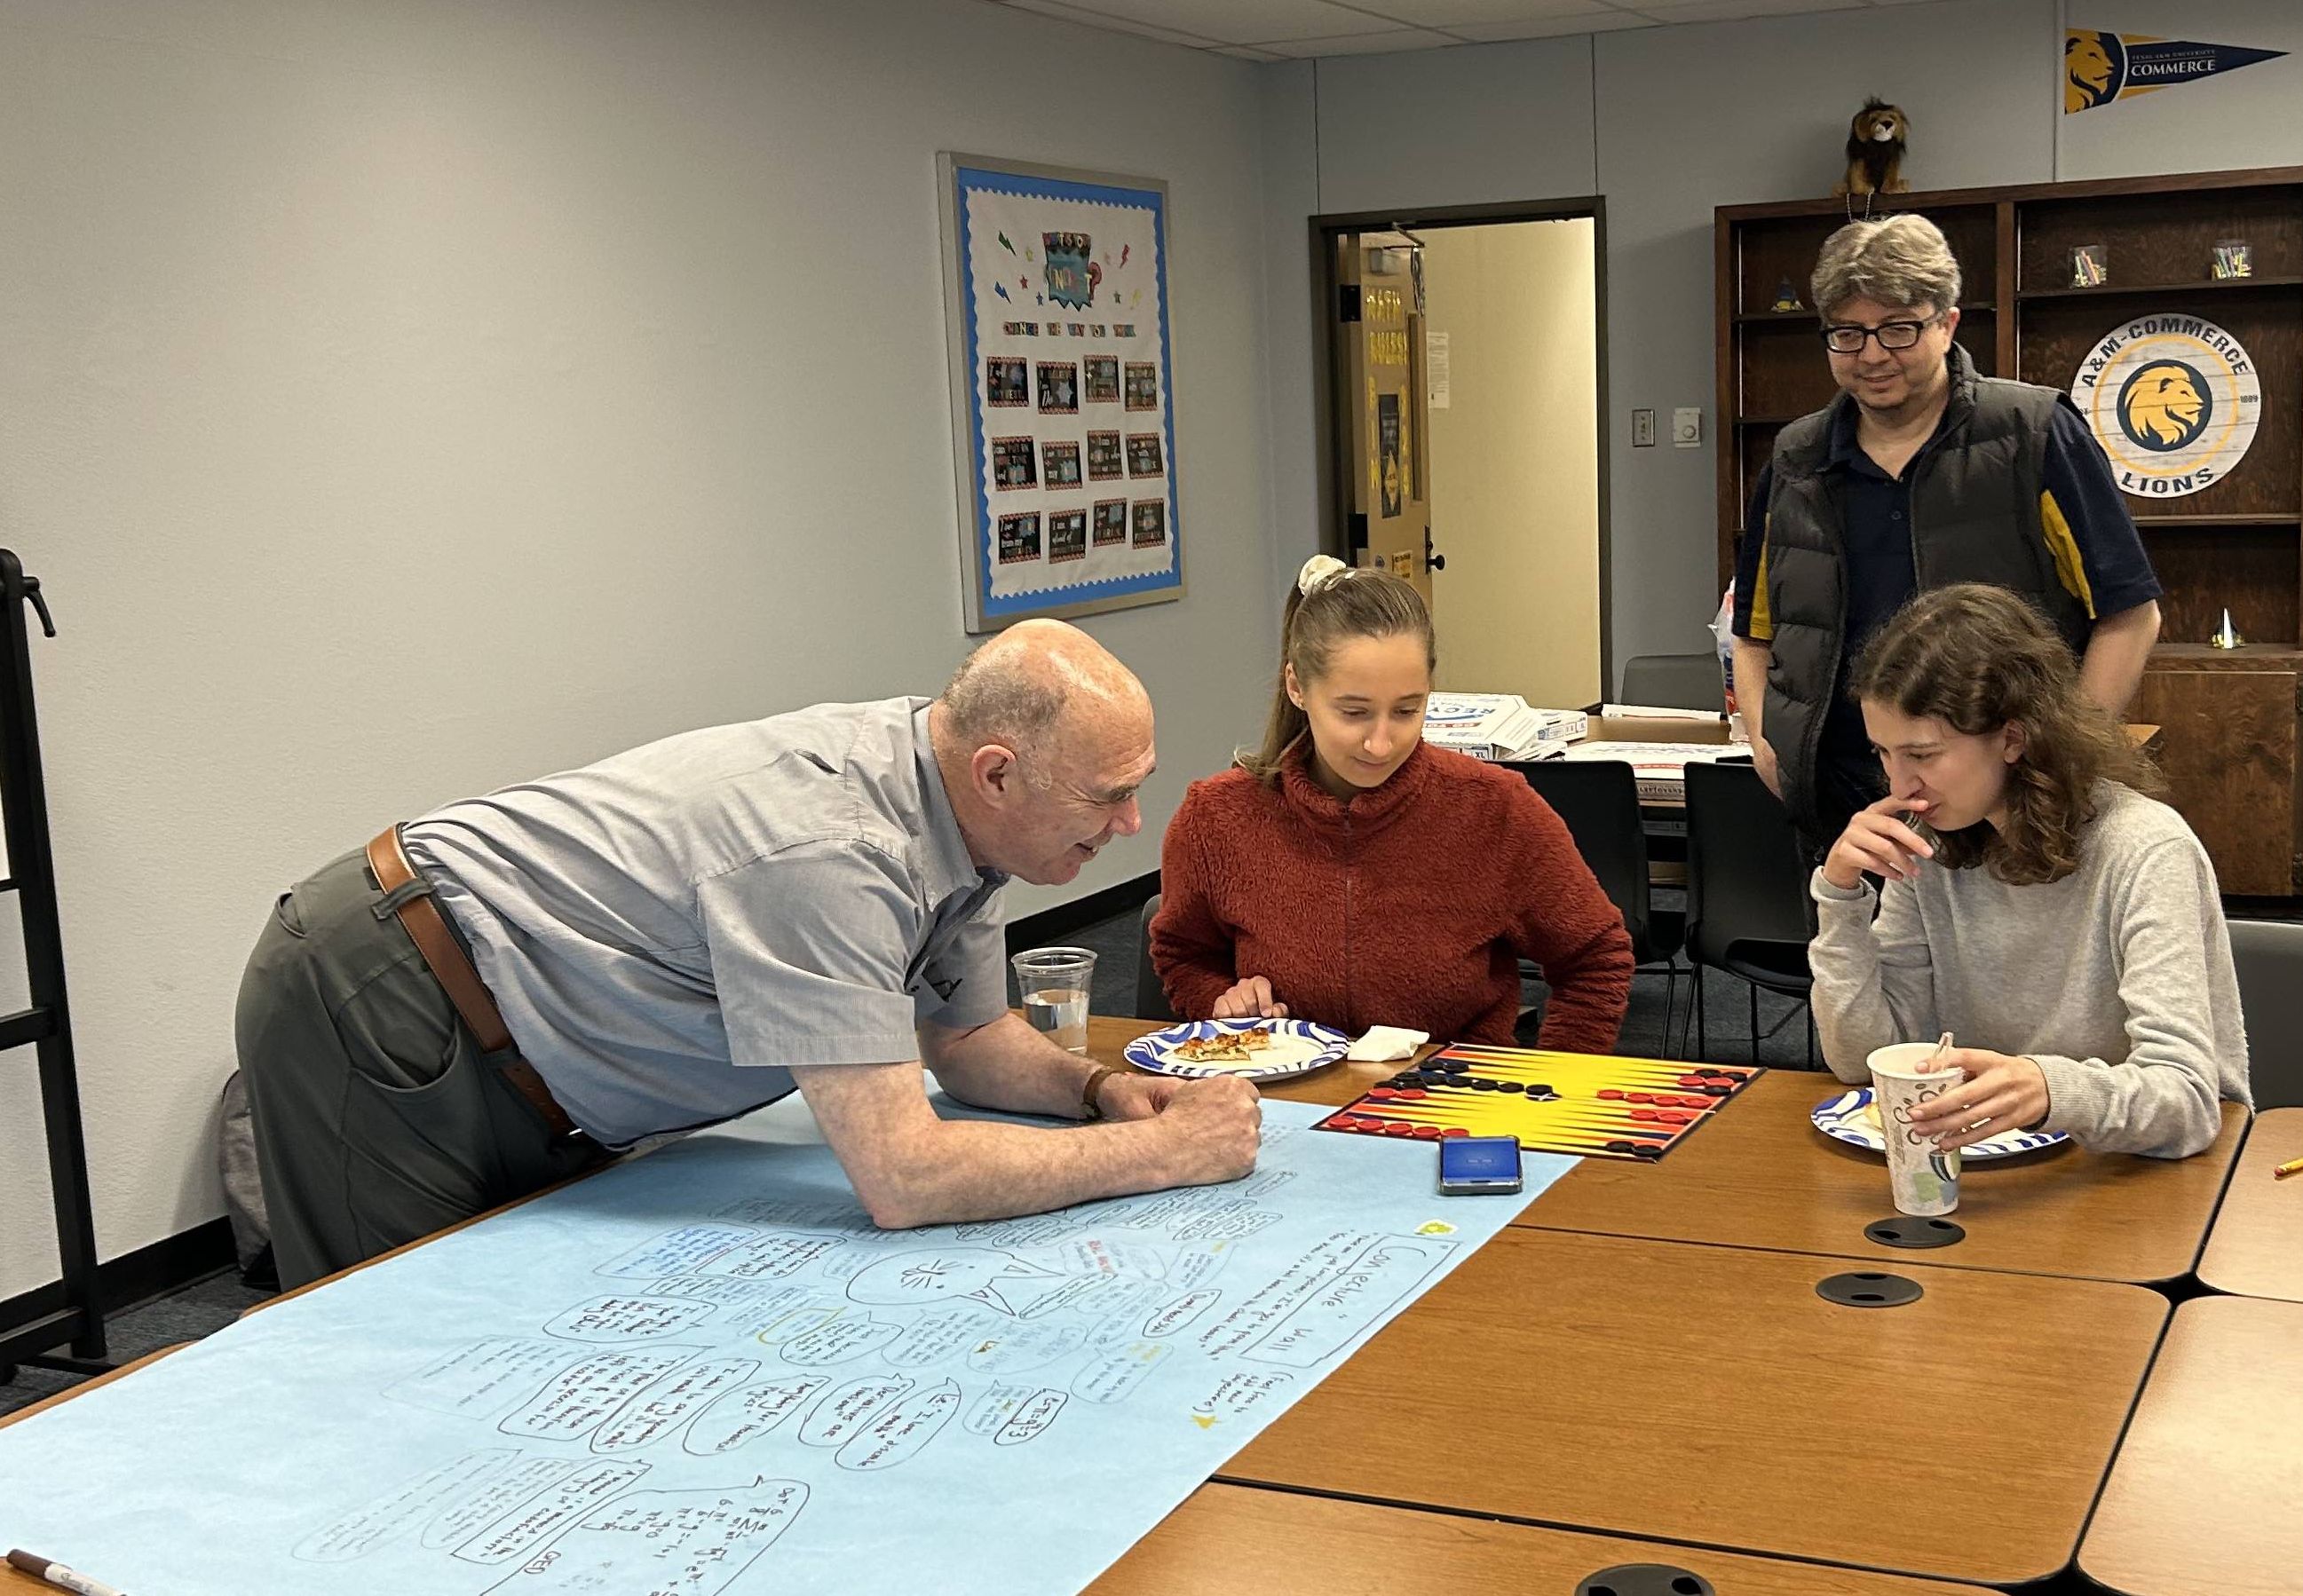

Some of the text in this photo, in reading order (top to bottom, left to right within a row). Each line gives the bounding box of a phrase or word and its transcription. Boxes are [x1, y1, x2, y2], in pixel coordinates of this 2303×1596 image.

[2131, 59, 2216, 76] COMMERCE
[2121, 467, 2215, 494] LIONS
[1267, 1327, 1314, 1352] Wall
